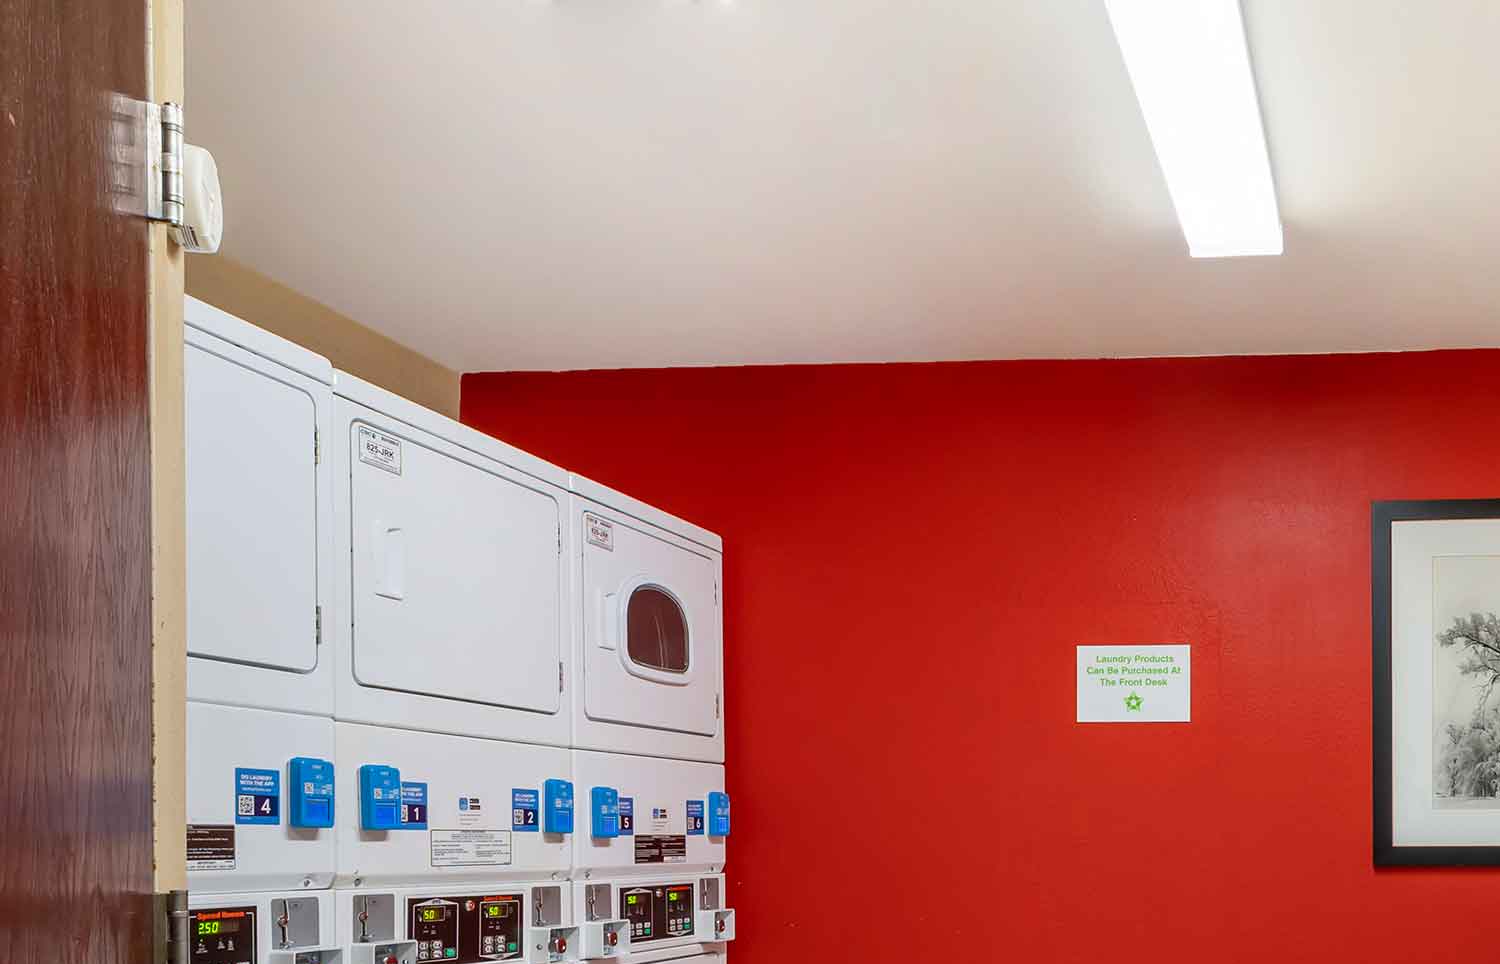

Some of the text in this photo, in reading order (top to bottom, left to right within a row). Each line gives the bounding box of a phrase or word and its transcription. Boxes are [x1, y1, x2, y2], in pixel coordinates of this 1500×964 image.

[1096, 655, 1174, 664] Laundry Products
[1121, 666, 1168, 675] Purchased
[1100, 678, 1116, 686] The
[1145, 678, 1168, 686] Desk
[261, 798, 271, 814] 4
[413, 807, 419, 821] 1
[528, 812, 534, 824] 2
[624, 817, 630, 828] 5
[696, 819, 701, 828] 6
